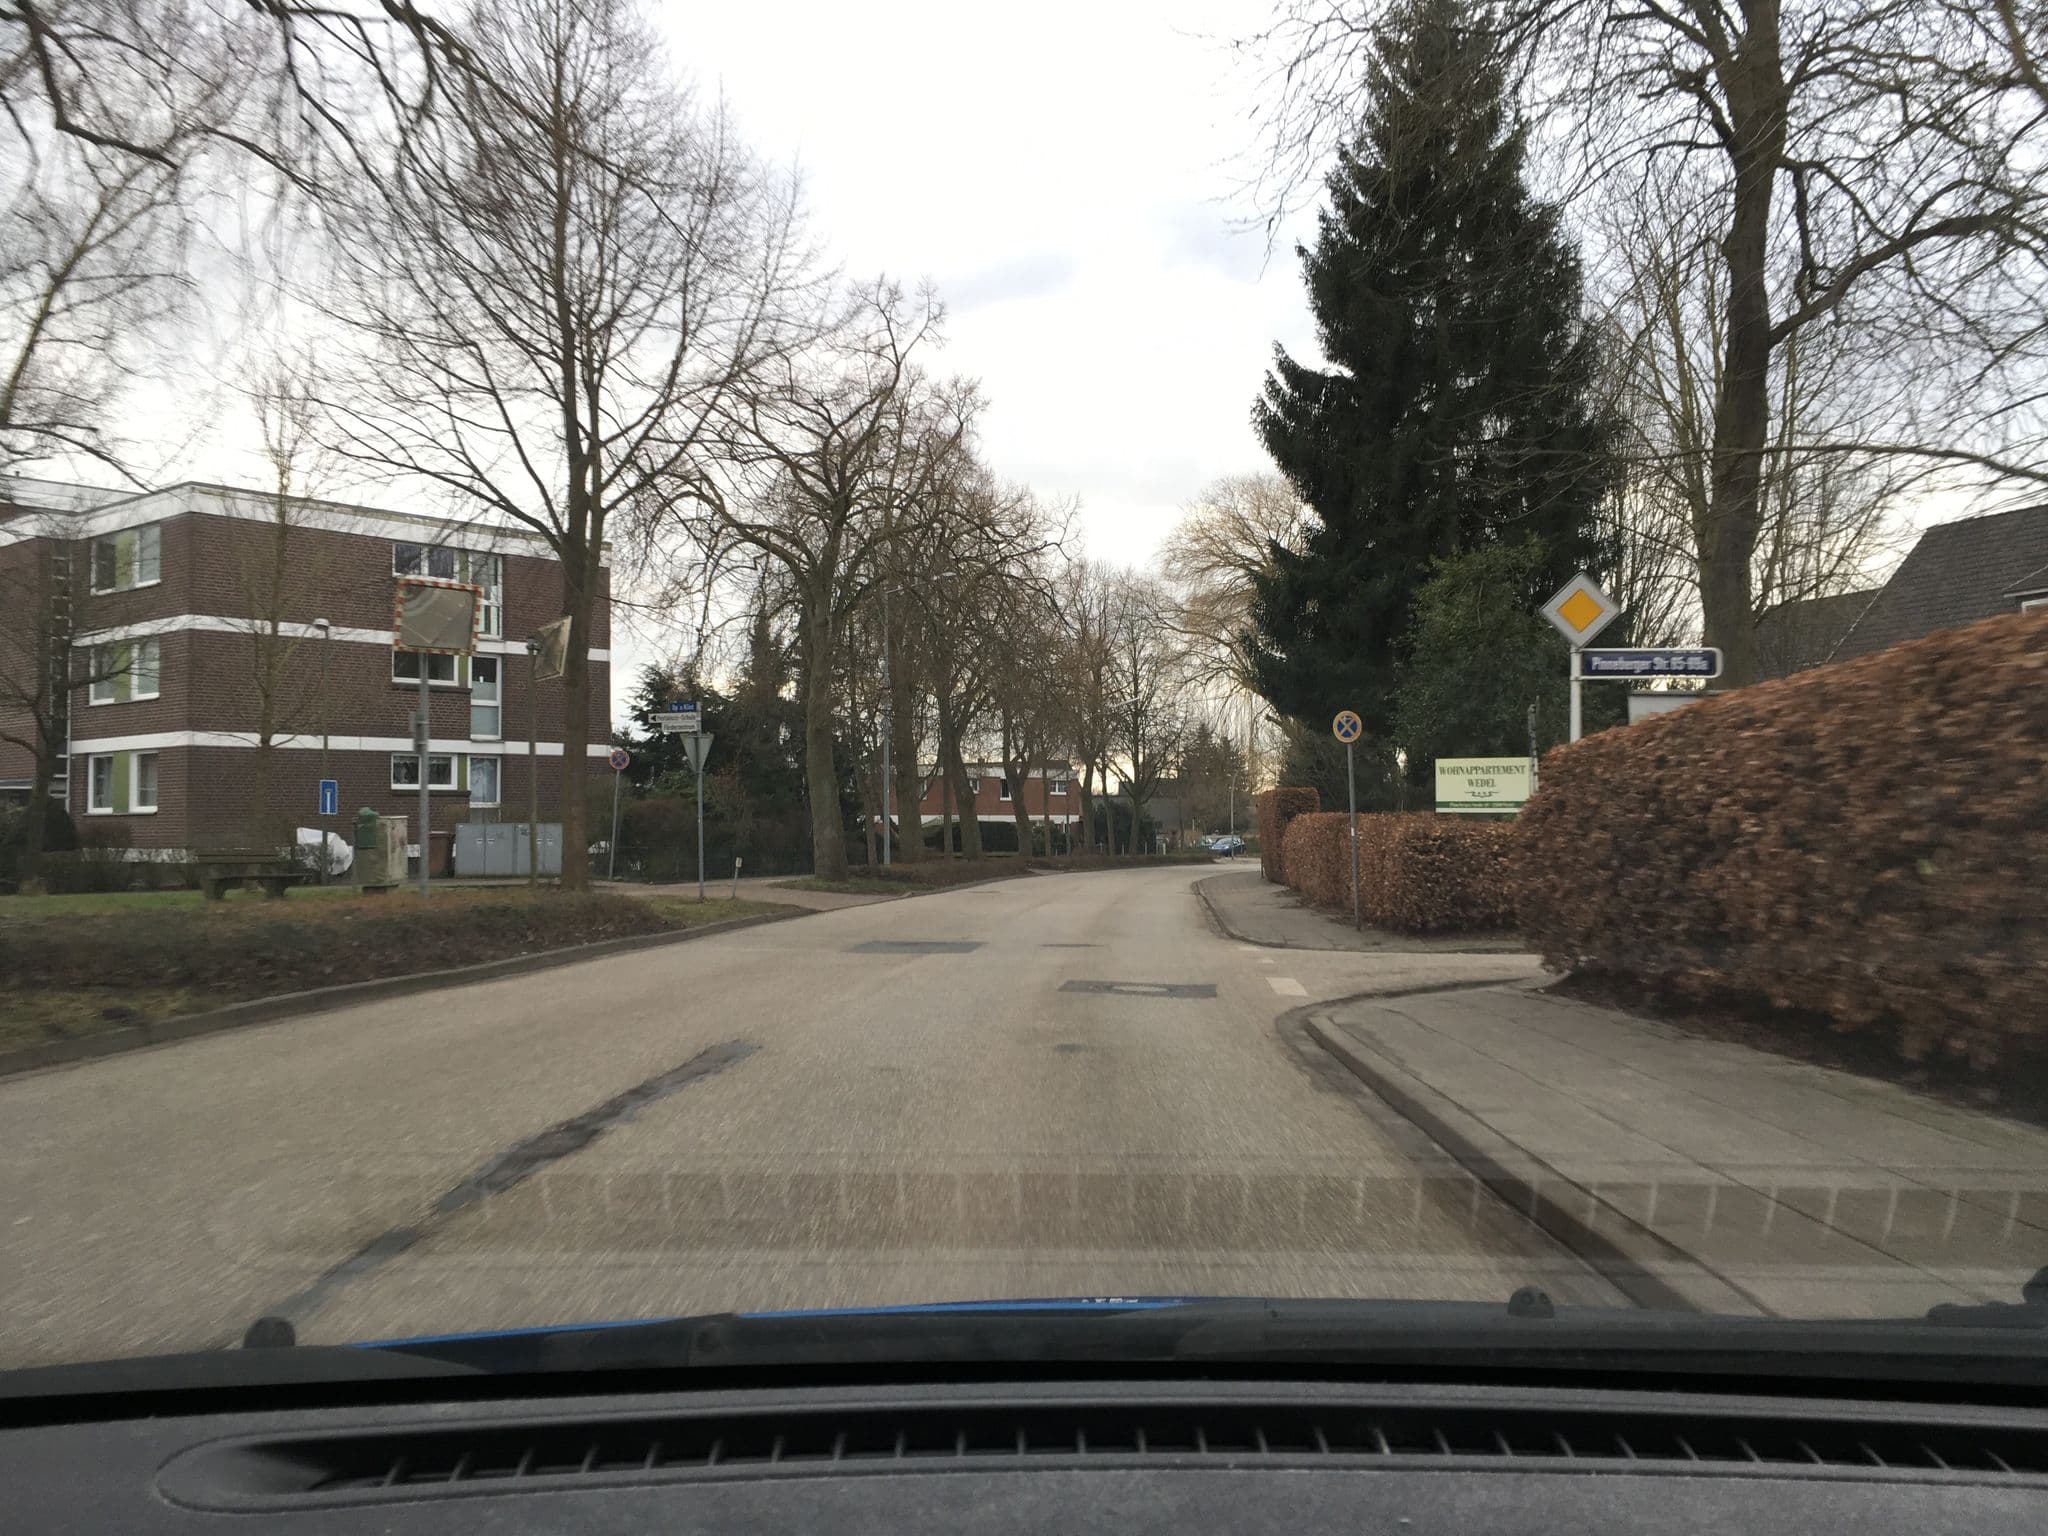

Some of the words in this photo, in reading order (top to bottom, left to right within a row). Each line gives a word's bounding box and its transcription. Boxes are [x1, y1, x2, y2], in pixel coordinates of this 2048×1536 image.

[1591, 656, 1651, 673] Pinneberger
[1439, 765, 1526, 776] WOHNAPPARTEMENT
[1467, 778, 1496, 788] WEDEL
